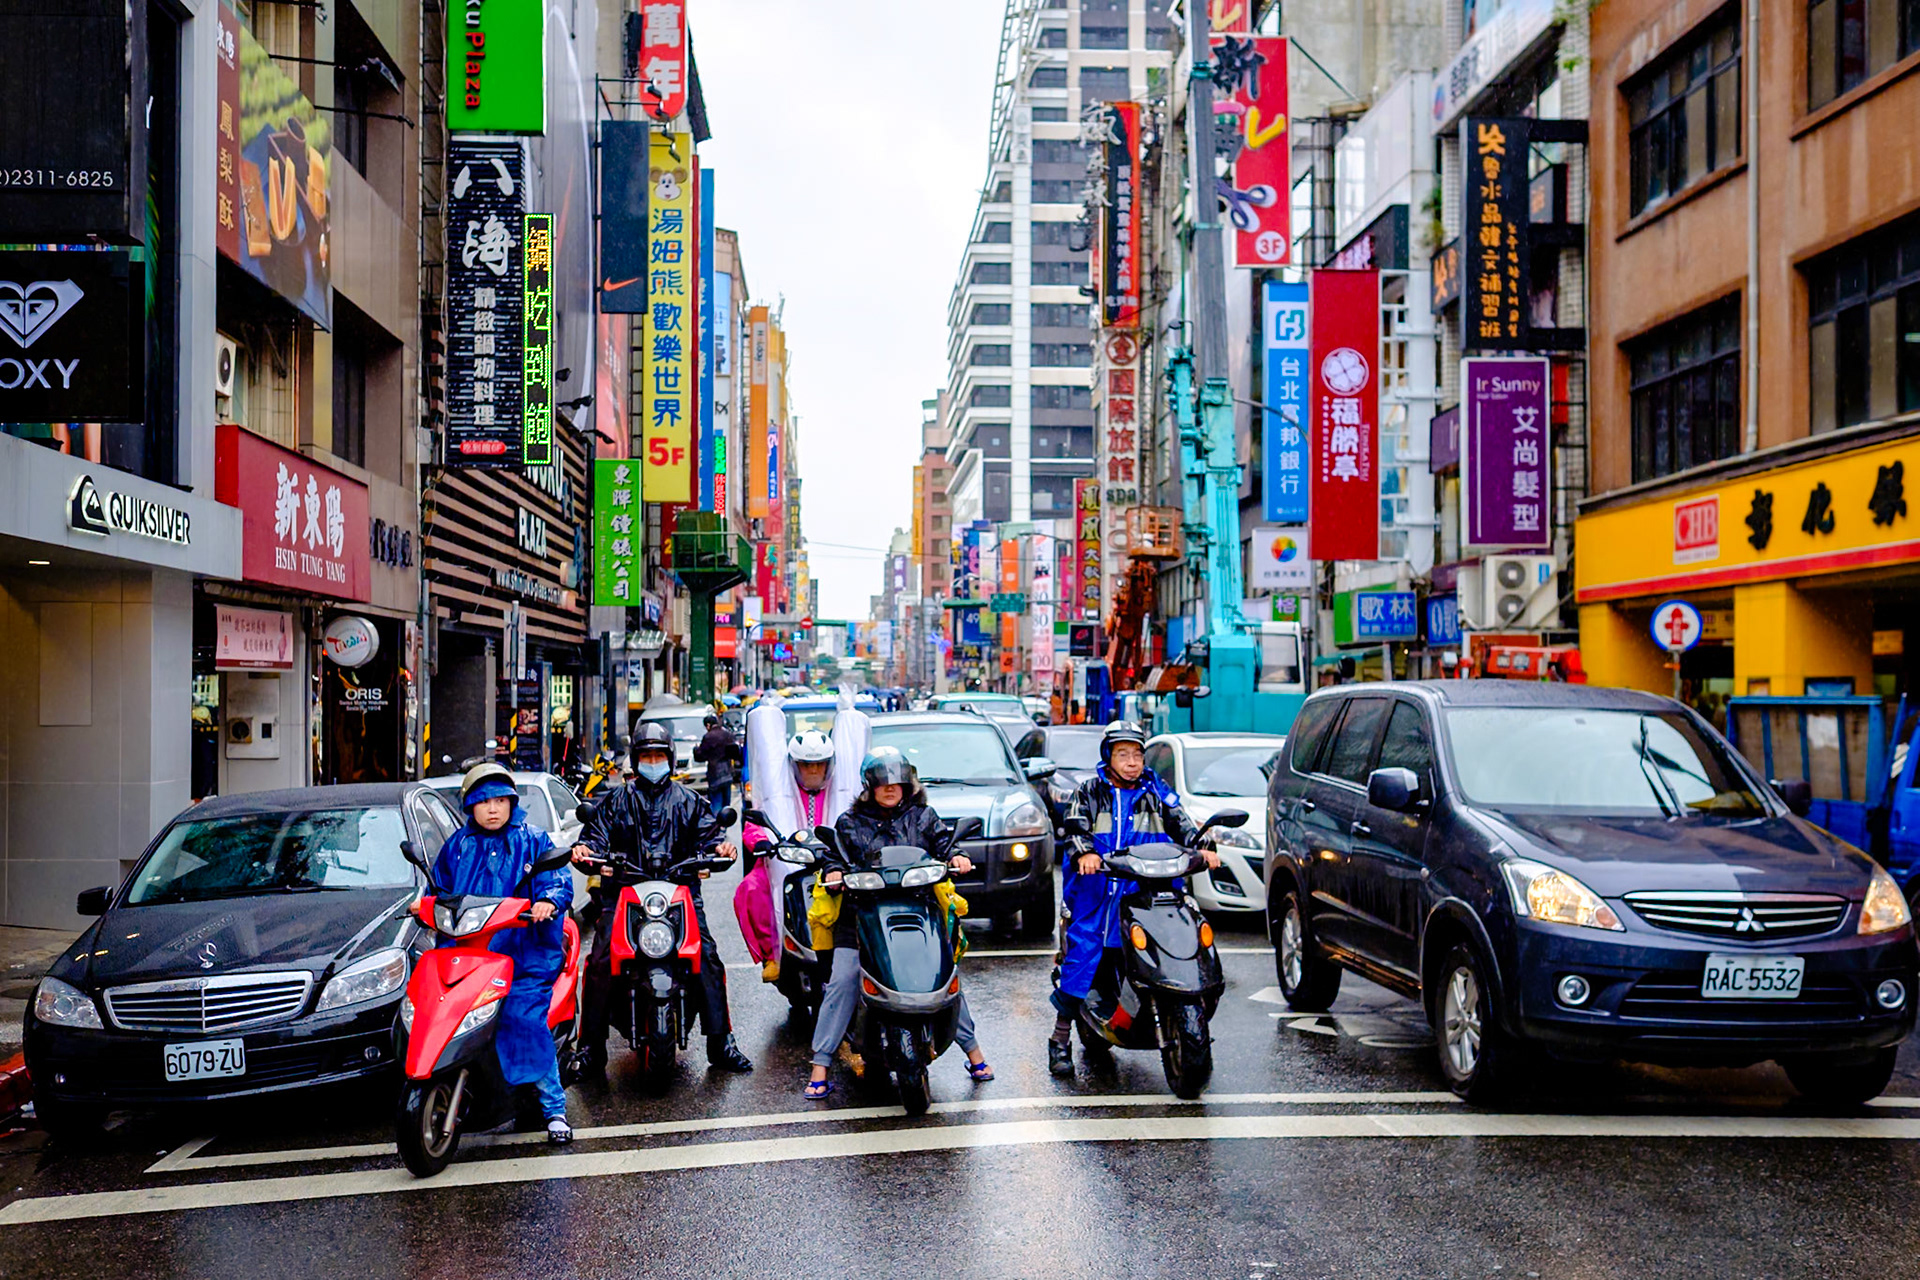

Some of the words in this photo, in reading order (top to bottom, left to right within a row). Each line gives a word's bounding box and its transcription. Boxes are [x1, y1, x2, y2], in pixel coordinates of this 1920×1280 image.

[465, 32, 486, 107] Plaza
[644, 3, 681, 100] 萬年
[218, 100, 234, 231] 鳳梨酥
[1260, 239, 1281, 254] 3F
[650, 208, 685, 428] 湯姆熊歡樂世界
[1491, 376, 1541, 396] Sunny
[1107, 368, 1136, 483] 國際旅館
[1280, 357, 1300, 495] 台北富邦銀行
[1331, 397, 1361, 482] 福勝亭
[648, 438, 685, 467] 5F
[1512, 405, 1540, 531] 艾尚髮型
[109, 491, 191, 544] QUIKSILVER
[274, 461, 346, 558] 新東陽
[1106, 487, 1137, 505] spa
[518, 506, 547, 559] PLAZA
[275, 546, 298, 573] HSIN
[301, 552, 324, 578] TUNG
[325, 558, 346, 584] YANG
[1361, 595, 1413, 621] 歌林
[345, 687, 382, 700] ORIS
[1705, 968, 1800, 991] RAC-5532
